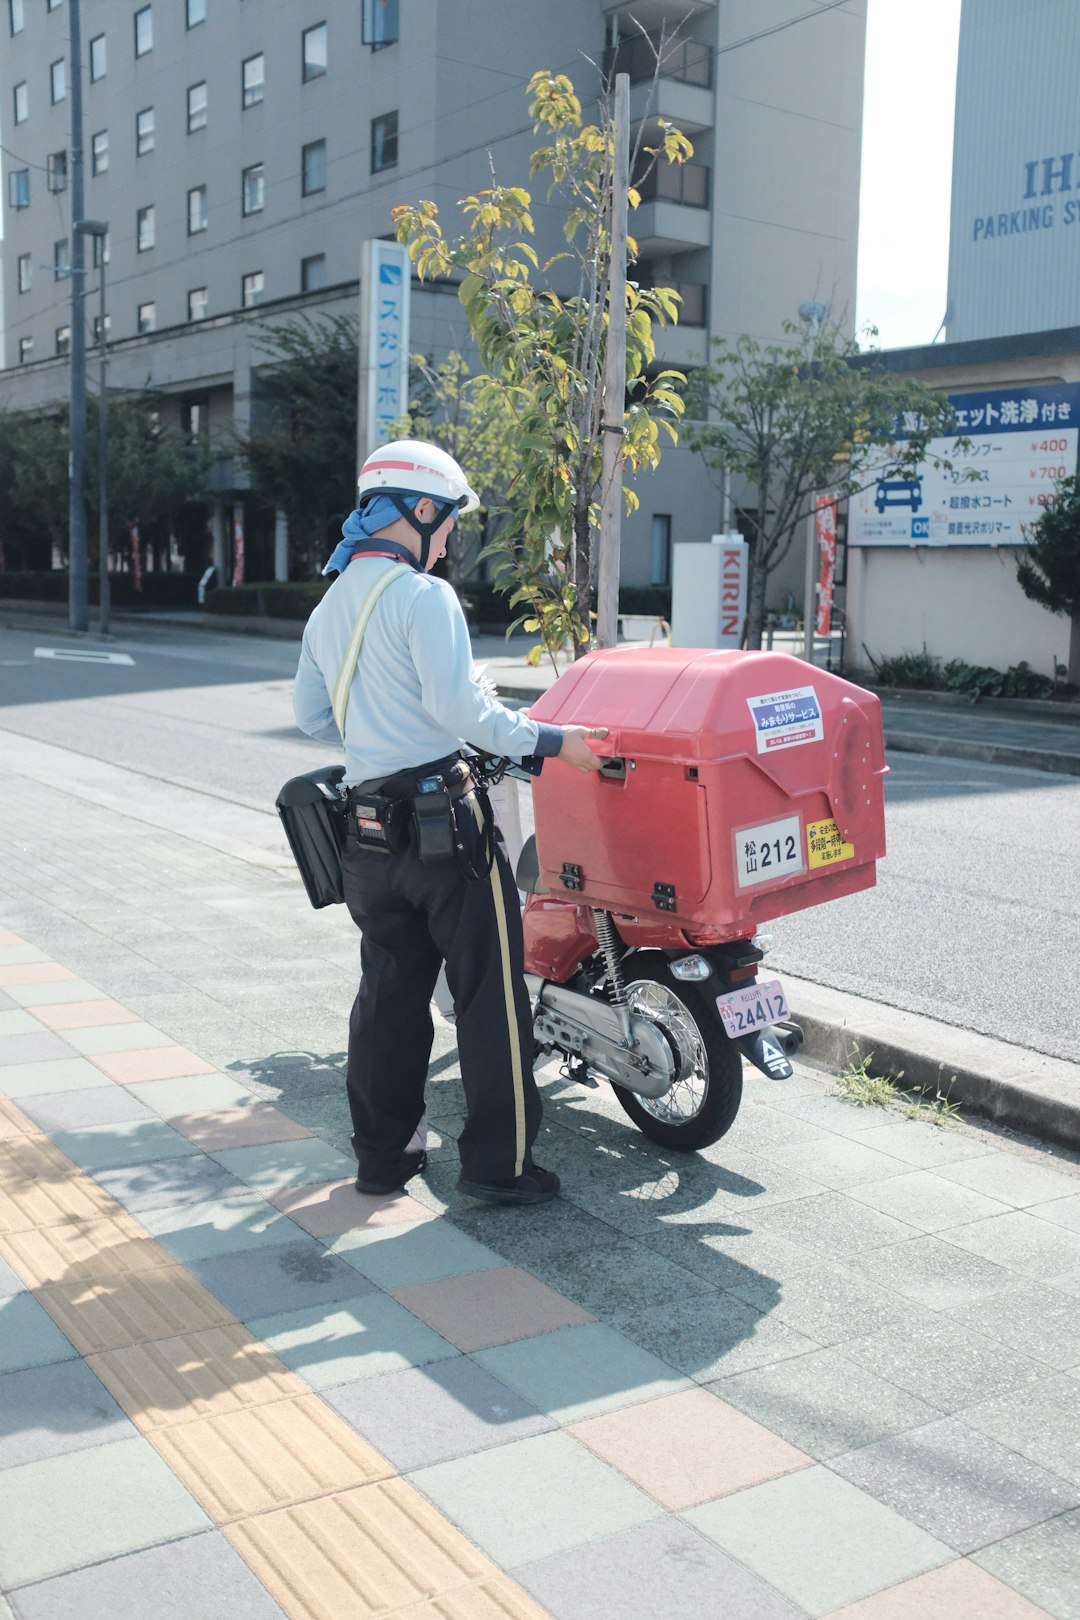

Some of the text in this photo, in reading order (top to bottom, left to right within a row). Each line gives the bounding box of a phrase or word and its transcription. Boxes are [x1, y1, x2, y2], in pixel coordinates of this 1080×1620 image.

[1023, 152, 1080, 199] IH
[973, 205, 1053, 241] PARKING
[1031, 438, 1068, 453] ¥400
[951, 465, 1066, 485] ワッス ¥700
[721, 550, 741, 636] KIRIN
[761, 708, 817, 728] みまもりサービス
[745, 835, 797, 875] 松山 212
[735, 994, 788, 1031] 24412
[740, 990, 762, 1002] 松山市
